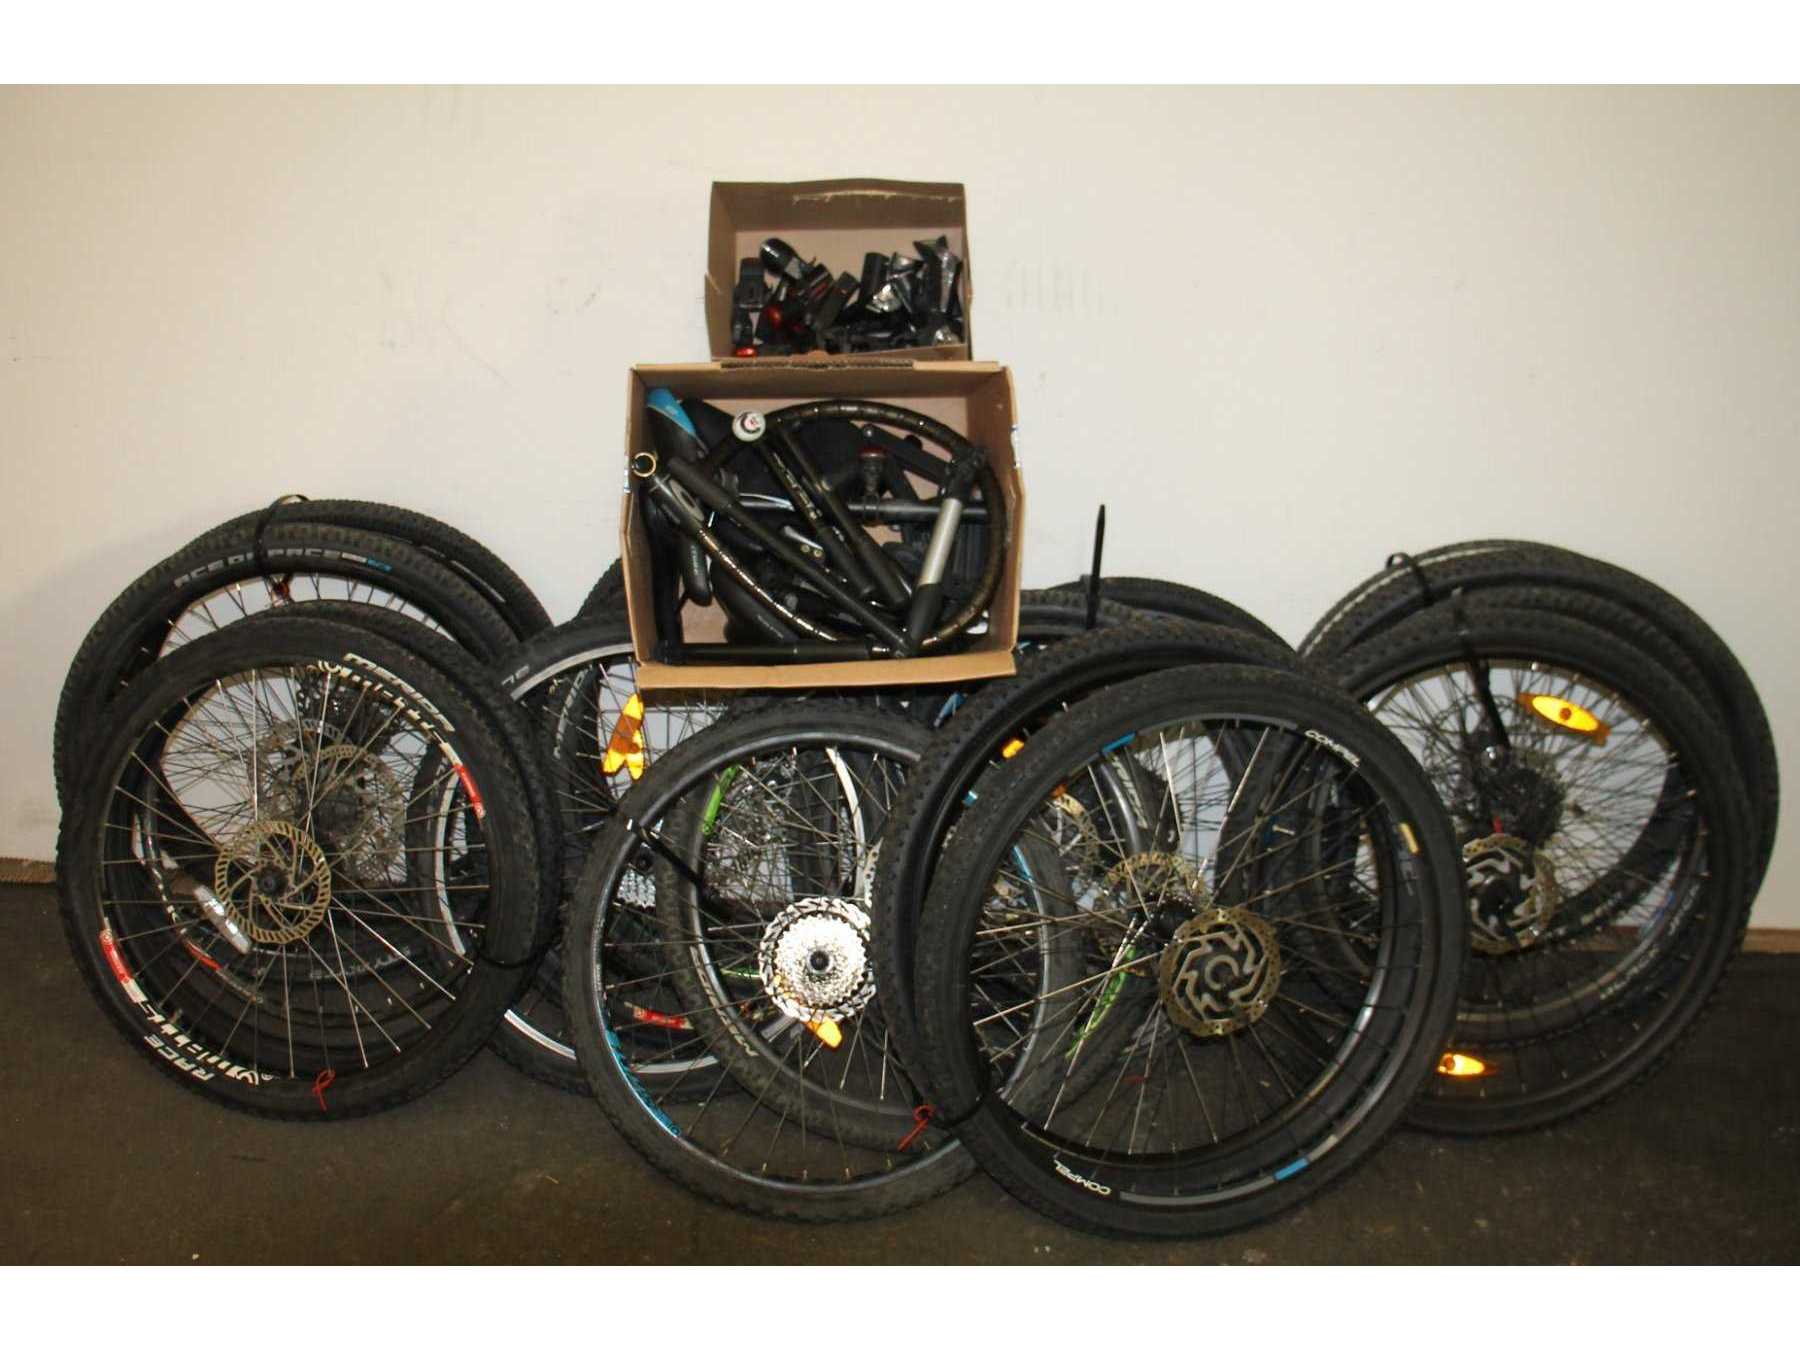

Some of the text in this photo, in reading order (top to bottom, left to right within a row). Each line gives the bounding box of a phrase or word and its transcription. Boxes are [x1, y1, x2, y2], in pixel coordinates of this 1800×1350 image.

[1305, 729, 1361, 769] COMPEL
[144, 1034, 215, 1082] RACE
[1053, 1158, 1113, 1196] COMPEL
